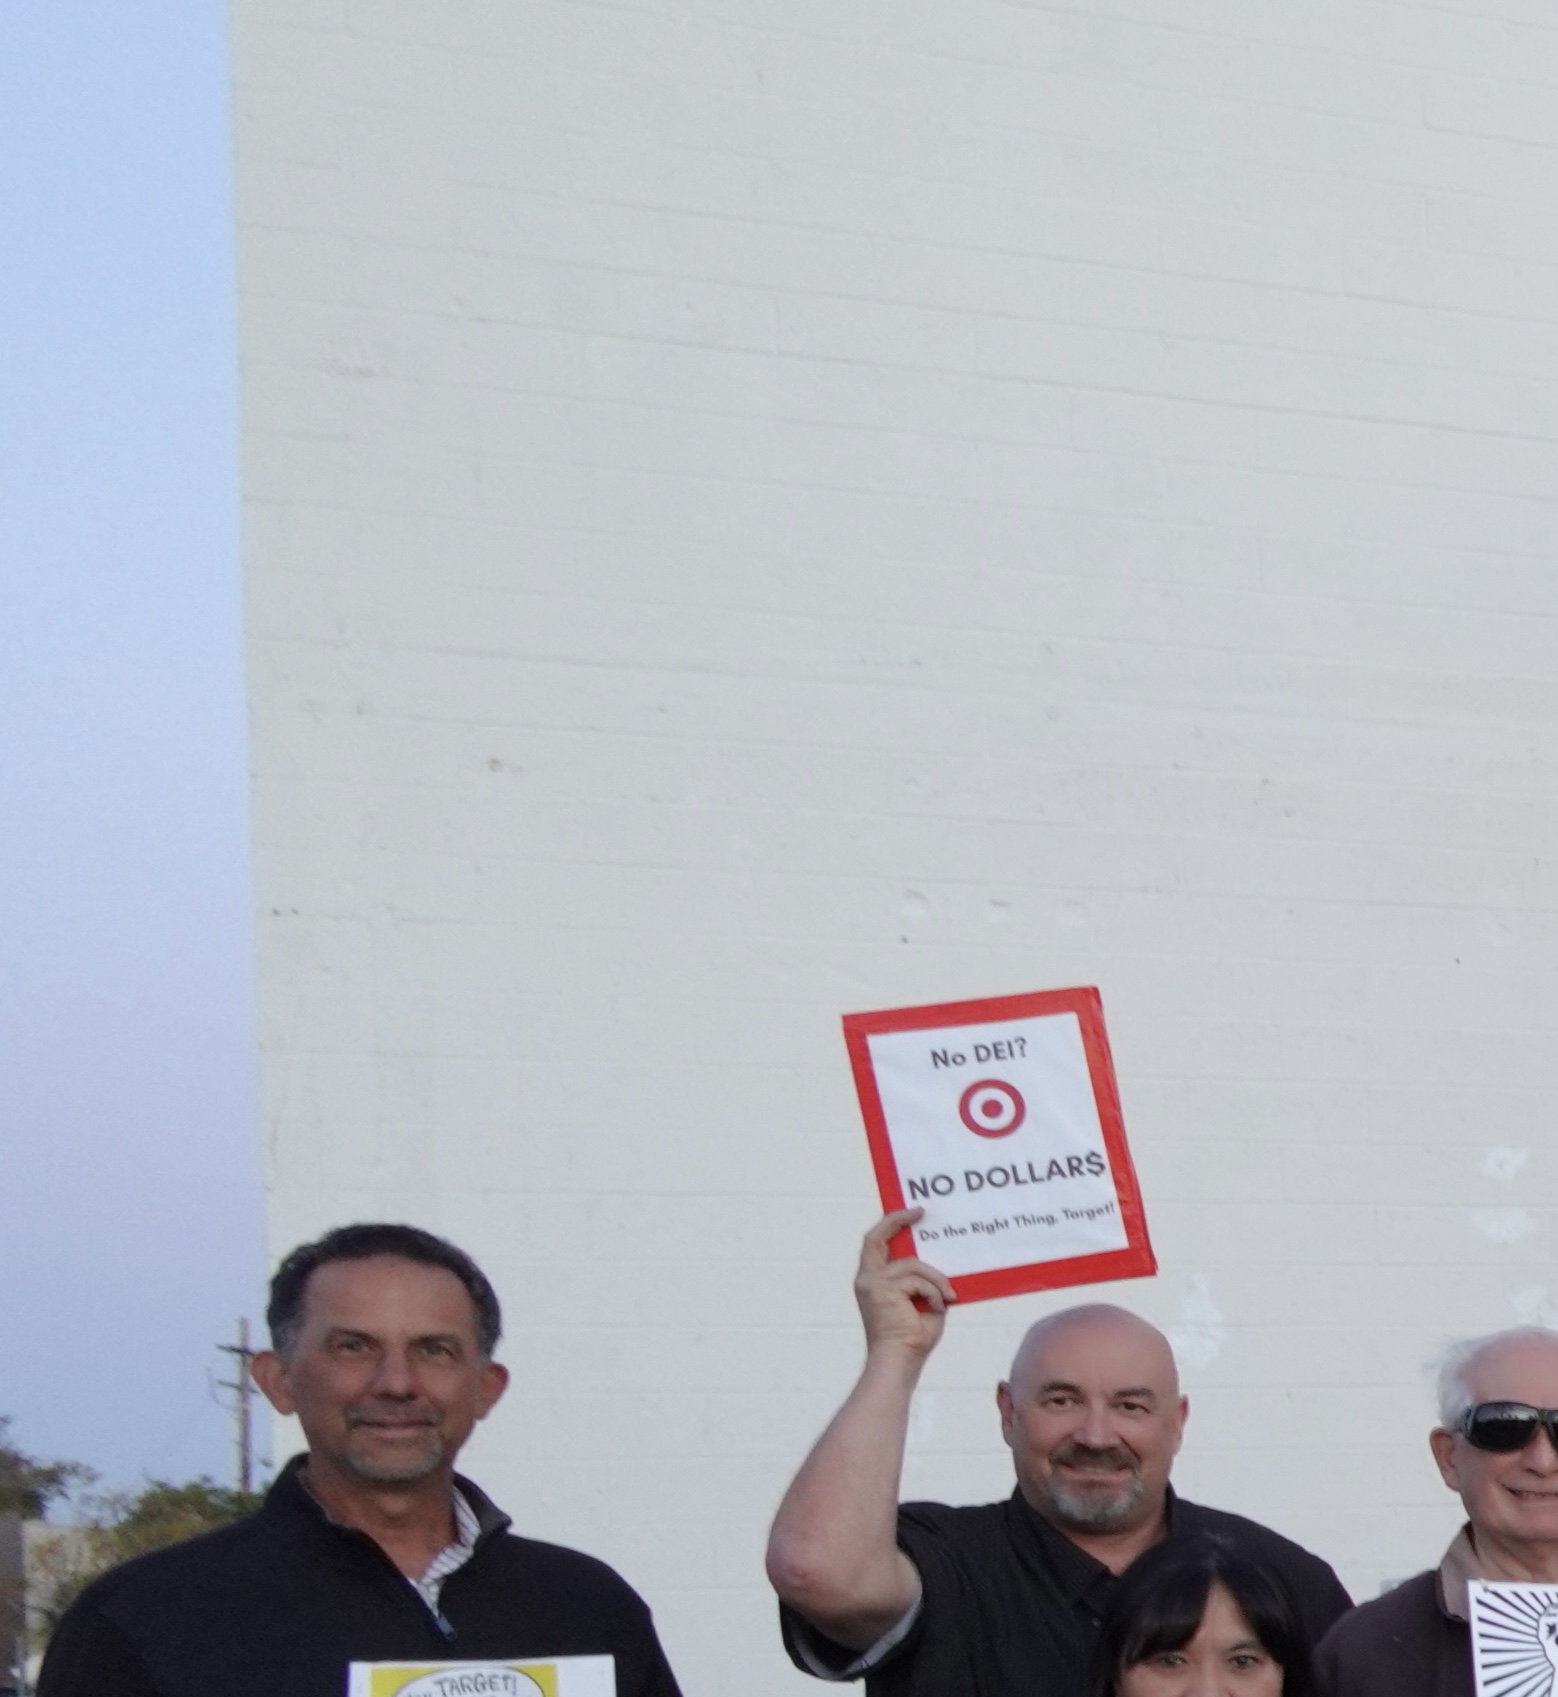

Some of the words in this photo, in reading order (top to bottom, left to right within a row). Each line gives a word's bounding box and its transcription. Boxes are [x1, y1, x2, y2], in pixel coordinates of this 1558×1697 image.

[930, 1049, 967, 1069] No
[973, 1037, 1028, 1064] DEI?
[907, 1175, 955, 1201] NO
[964, 1151, 1107, 1194] DOLLAR$
[919, 1228, 940, 1242] Do
[944, 1222, 968, 1239] the
[971, 1217, 1009, 1236] Right
[1062, 1201, 1115, 1222] Target!
